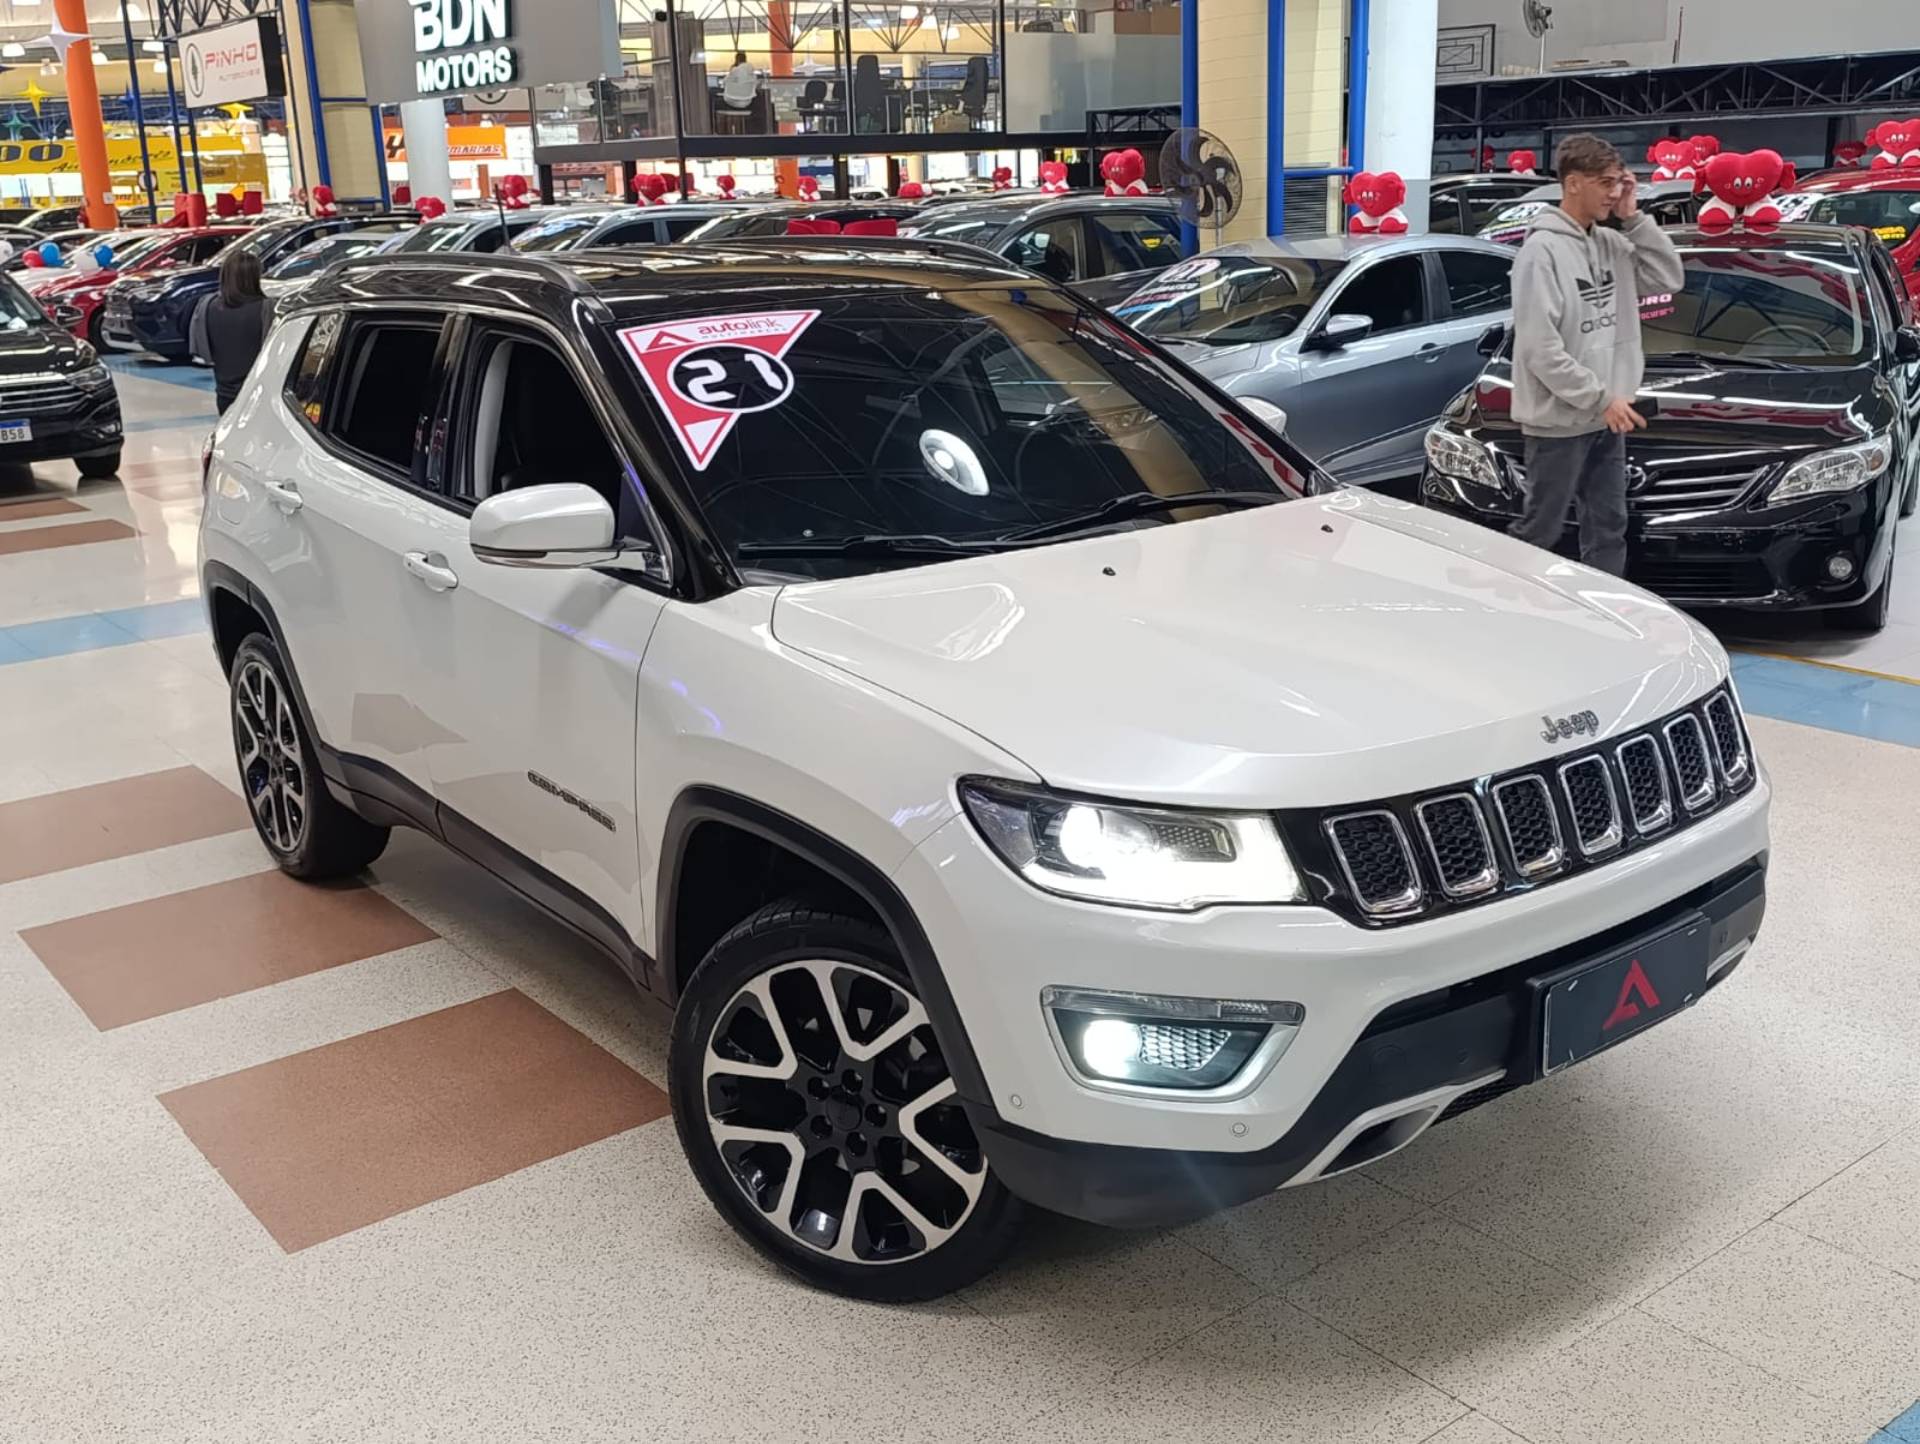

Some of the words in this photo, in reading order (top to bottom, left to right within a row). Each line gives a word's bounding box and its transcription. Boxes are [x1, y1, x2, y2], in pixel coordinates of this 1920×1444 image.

[408, 0, 506, 52] BDN
[415, 46, 512, 93] MOTORS
[697, 317, 783, 335] autolink
[681, 353, 784, 404] 21
[1540, 709, 1600, 744] Jeep
